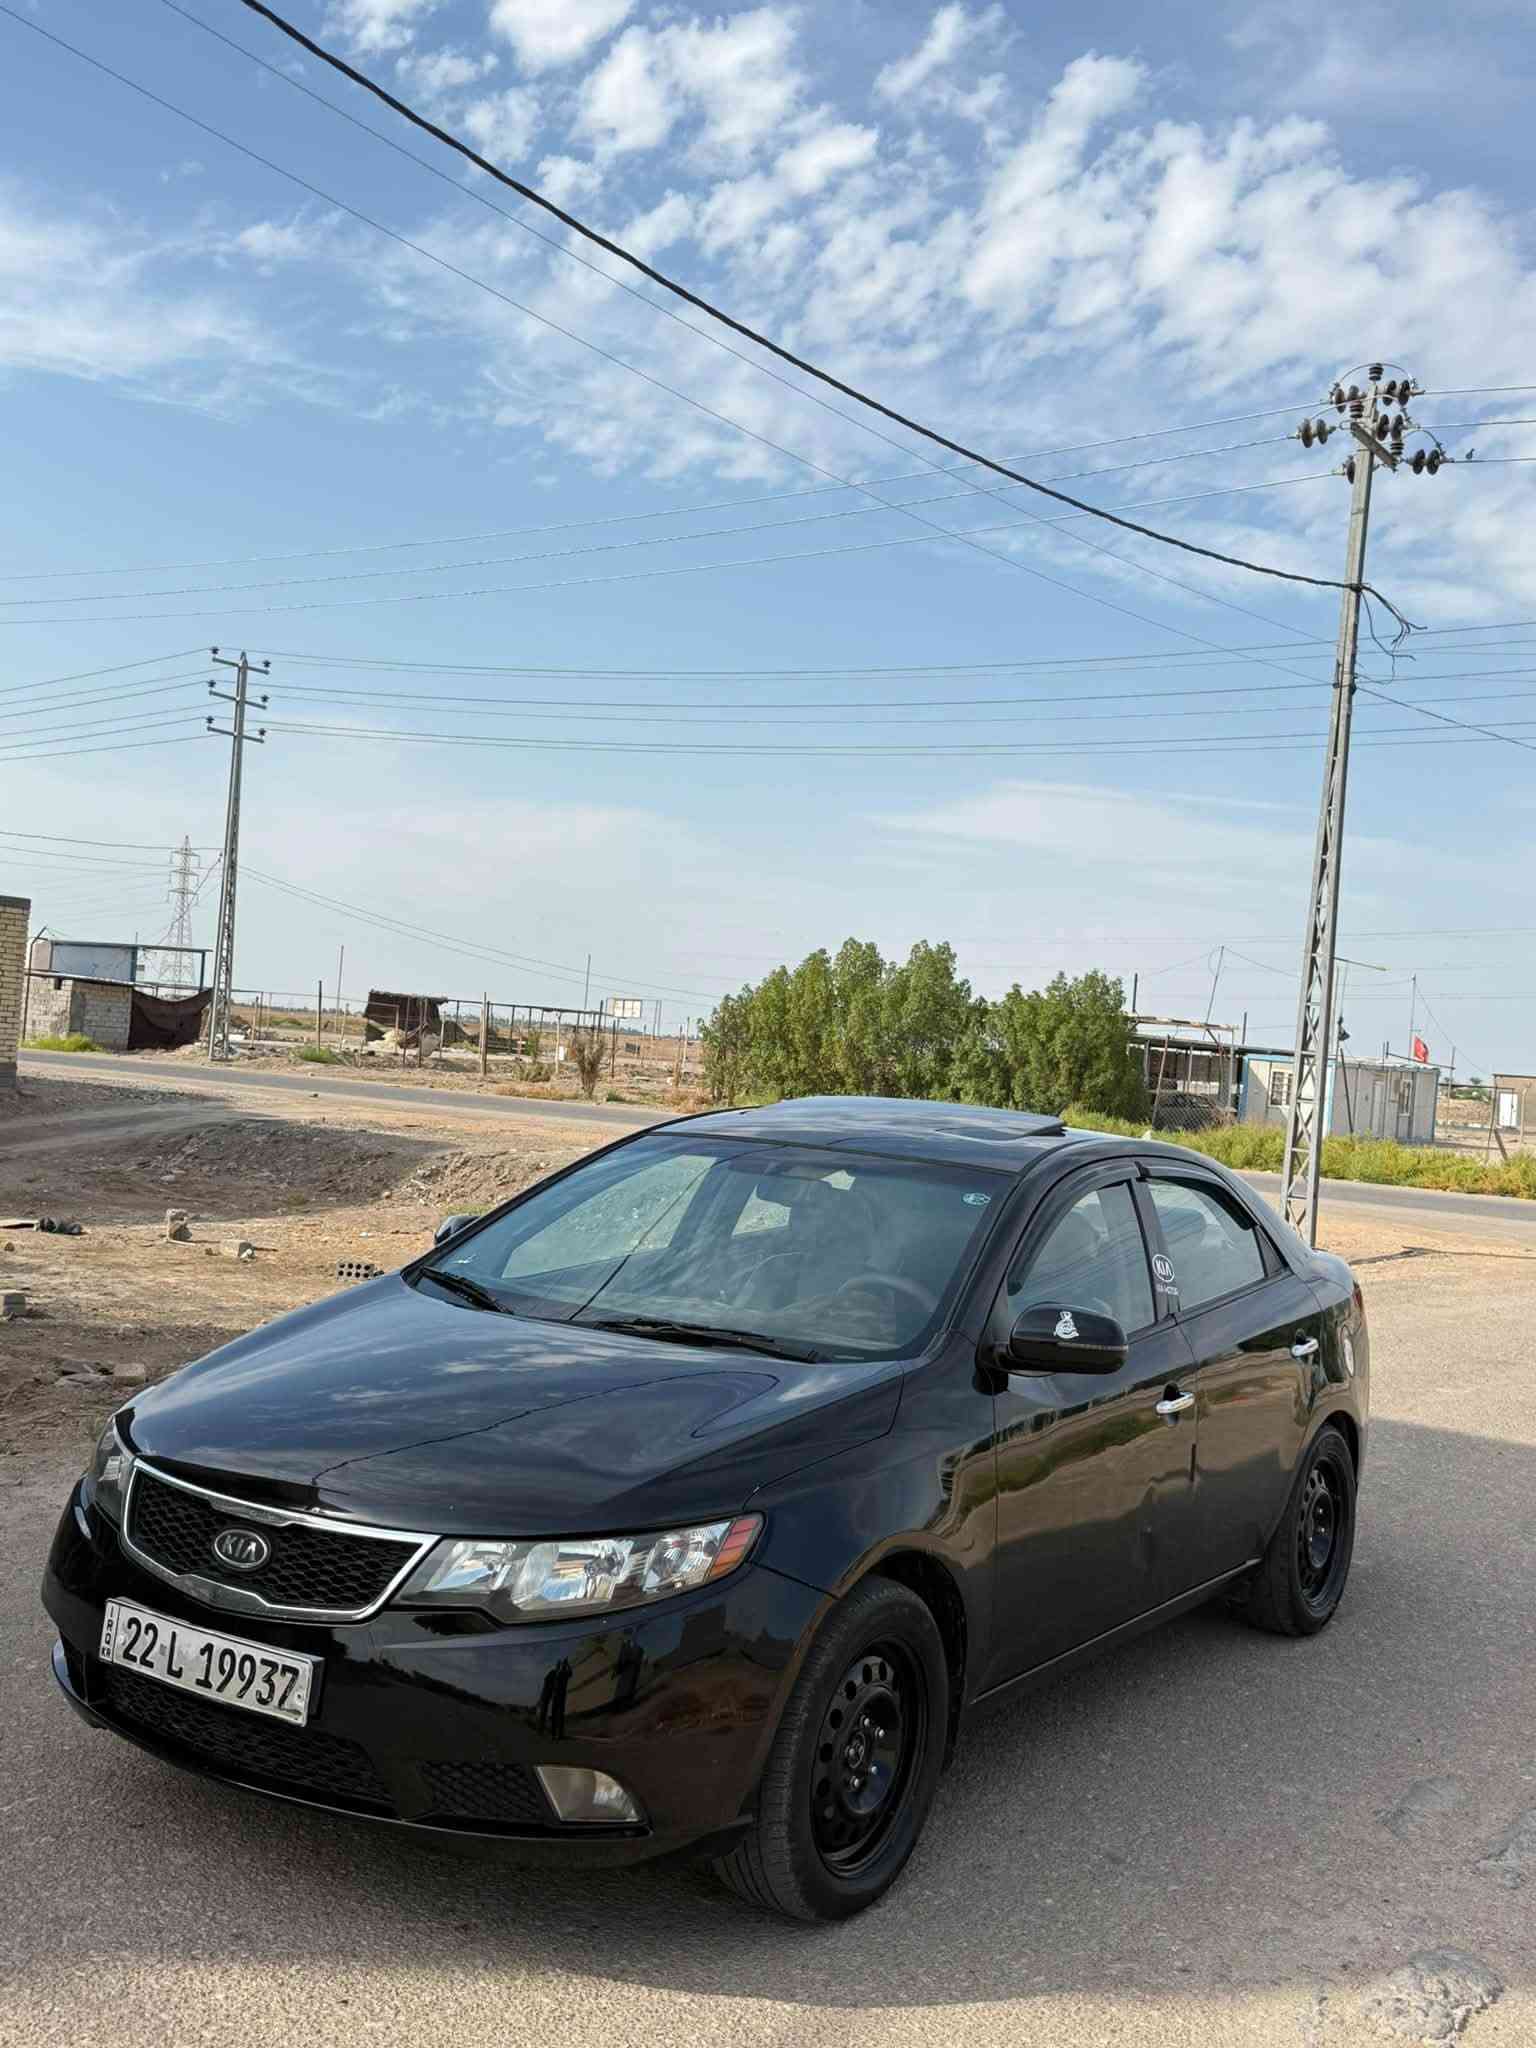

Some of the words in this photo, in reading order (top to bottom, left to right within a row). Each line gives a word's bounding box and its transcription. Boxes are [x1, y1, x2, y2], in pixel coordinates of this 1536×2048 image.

[222, 1534, 257, 1561] KIA
[122, 1616, 159, 1669] 22
[166, 1630, 183, 1679] L
[195, 1642, 300, 1709] 19937
